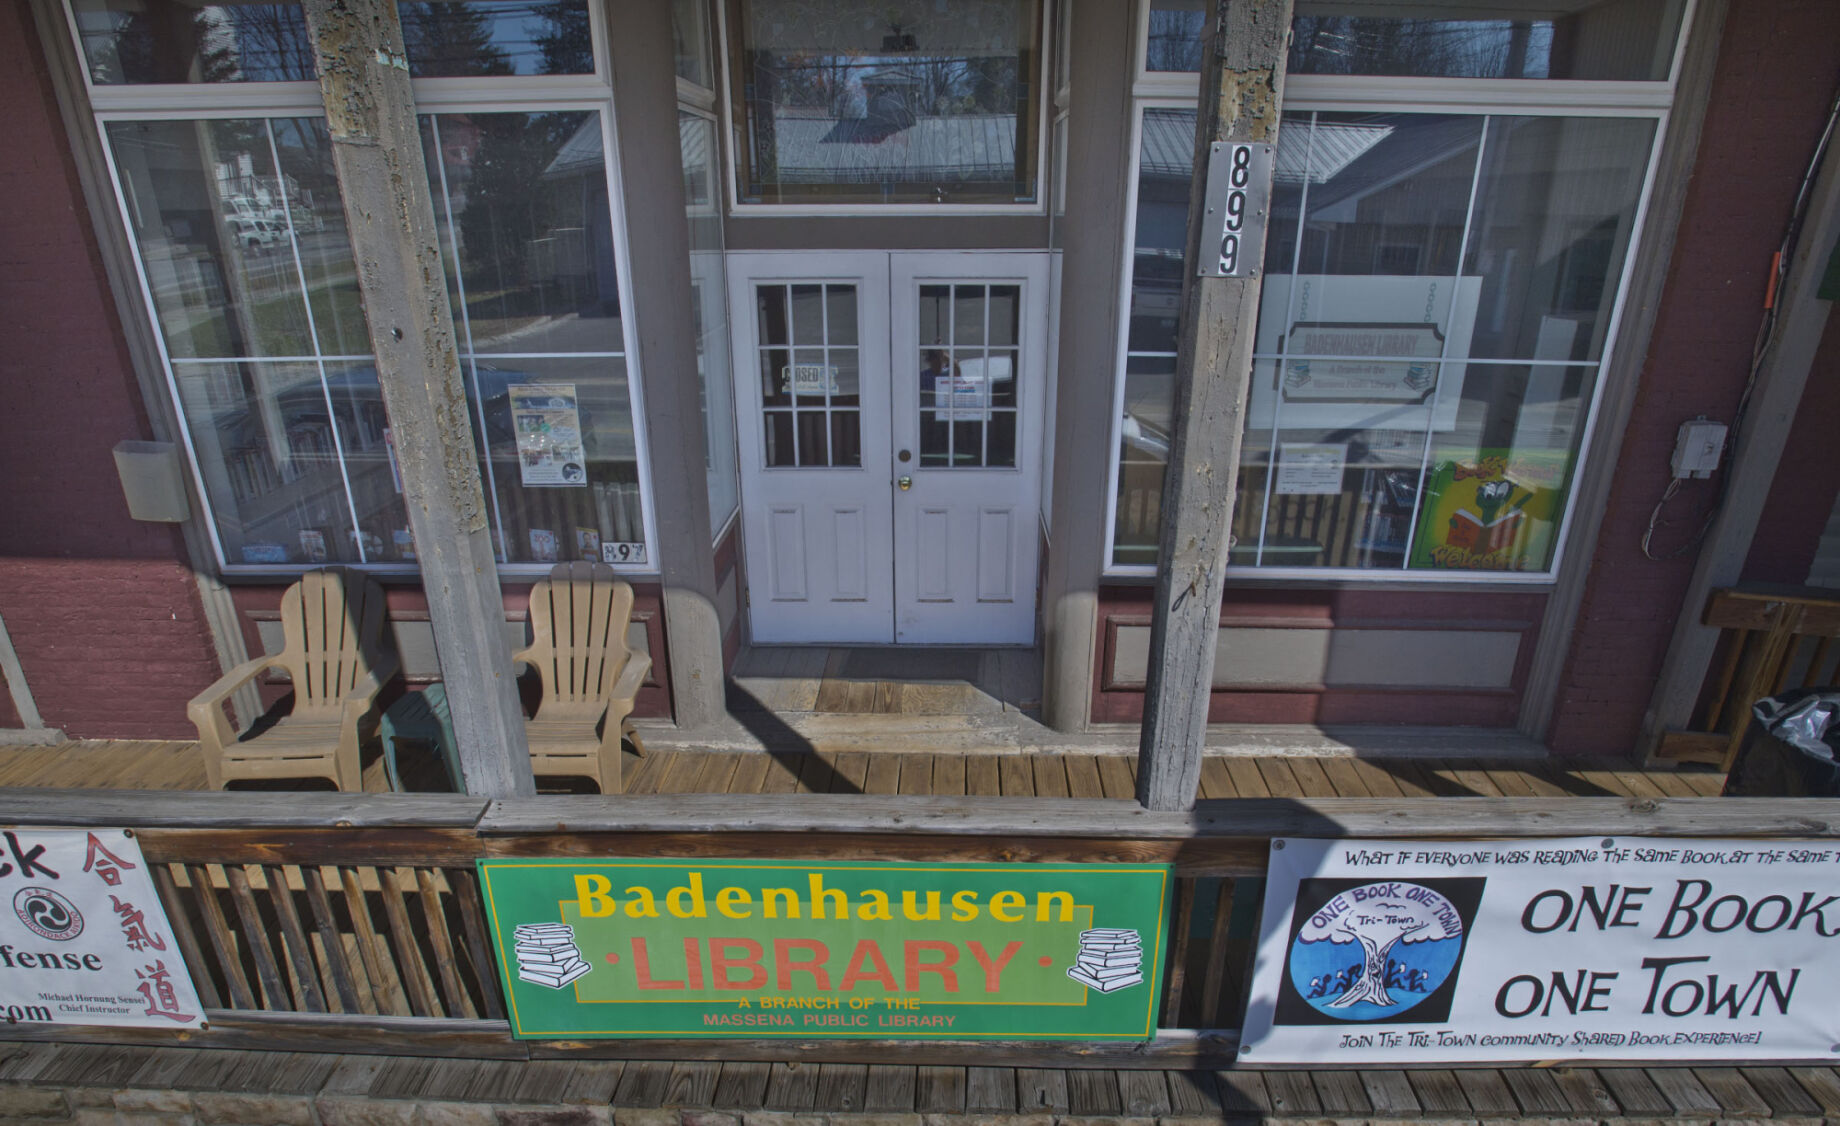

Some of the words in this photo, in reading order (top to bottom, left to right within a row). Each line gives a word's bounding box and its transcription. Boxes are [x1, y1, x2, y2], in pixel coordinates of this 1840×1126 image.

[1220, 146, 1250, 274] 899
[784, 367, 818, 382] COSED
[574, 872, 1074, 922] Badenhausen
[1312, 896, 1350, 929] ONE
[1352, 883, 1402, 903] BOOK
[1405, 887, 1440, 907] ONE
[1432, 902, 1463, 935] TOWN
[1521, 884, 1653, 933] ONE
[631, 937, 1024, 992] LIBRARY
[38, 992, 73, 1002] Michael
[59, 1003, 83, 1013] Chief
[86, 1004, 131, 1014] Instructor
[738, 997, 751, 1009] A
[760, 997, 840, 1009] BRANCH
[849, 997, 875, 1009] OF
[886, 998, 921, 1010] THE
[1495, 969, 1619, 1018] ONE
[703, 1014, 795, 1026] MASSENA
[803, 1014, 869, 1027] PUBLIC
[878, 1015, 957, 1027] LIBRARY
